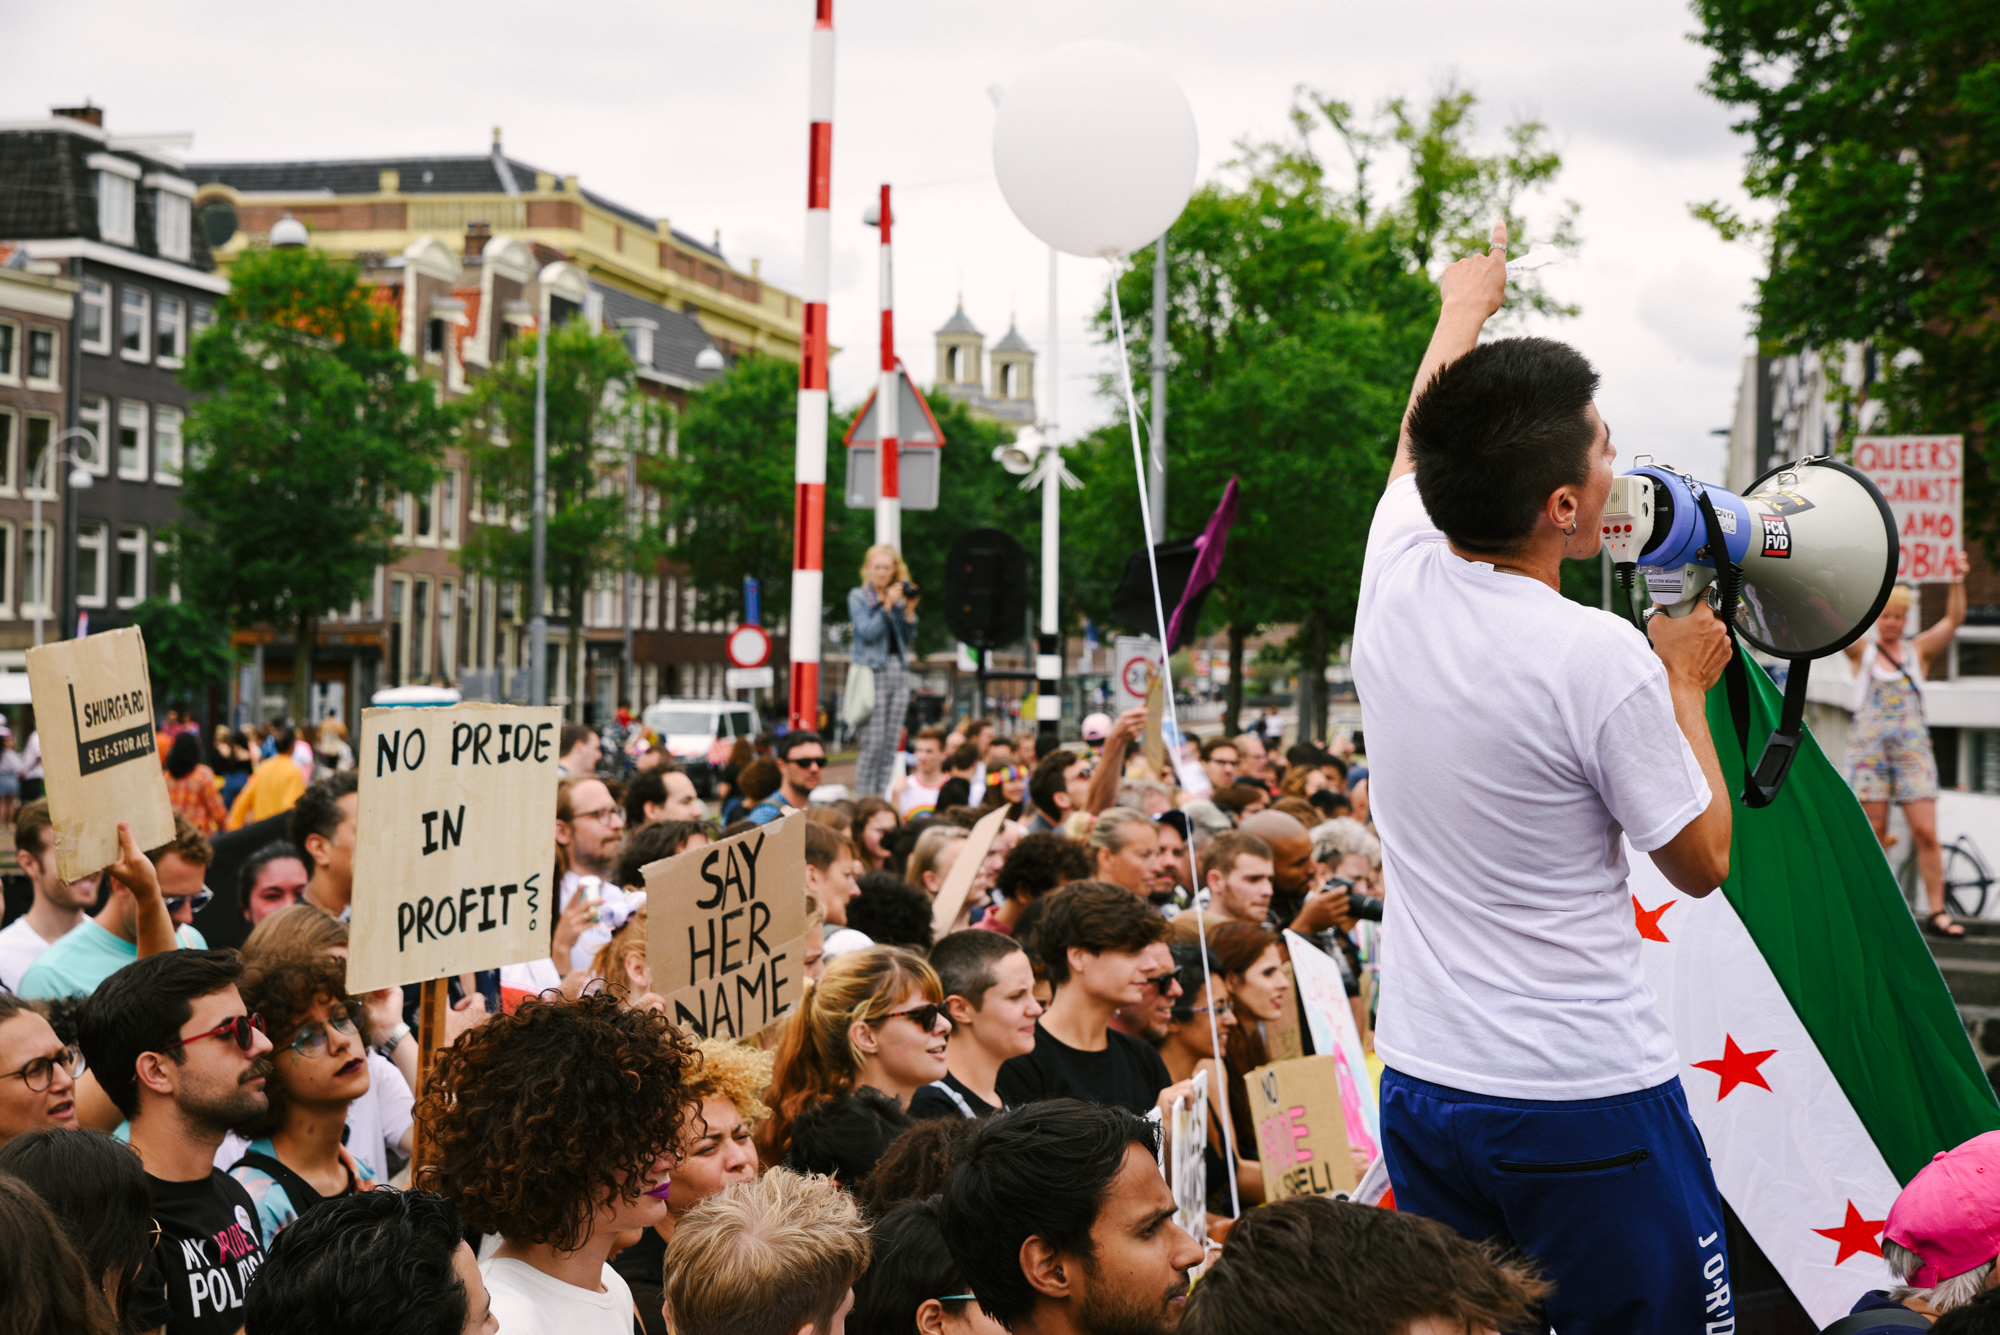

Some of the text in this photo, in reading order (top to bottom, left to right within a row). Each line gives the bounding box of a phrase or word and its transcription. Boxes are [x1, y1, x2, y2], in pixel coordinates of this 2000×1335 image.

[1855, 440, 1963, 472] QUEERS
[1875, 477, 1962, 506] GAINST
[1714, 509, 1735, 520] ONYX
[1763, 521, 1788, 535] FCK
[1902, 513, 1955, 538] AMO
[1765, 535, 1789, 549] FVD
[1897, 543, 1959, 578] OBIA
[84, 690, 145, 728] SHURGARD
[88, 732, 151, 764] SELF-STORAGE
[376, 722, 554, 778] NO PRIDE
[422, 805, 466, 856] IN
[696, 832, 765, 911] SAY
[688, 901, 771, 987] HER
[675, 953, 791, 1038] NAME
[179, 1238, 211, 1271] MY
[212, 1223, 254, 1264] PRIDE
